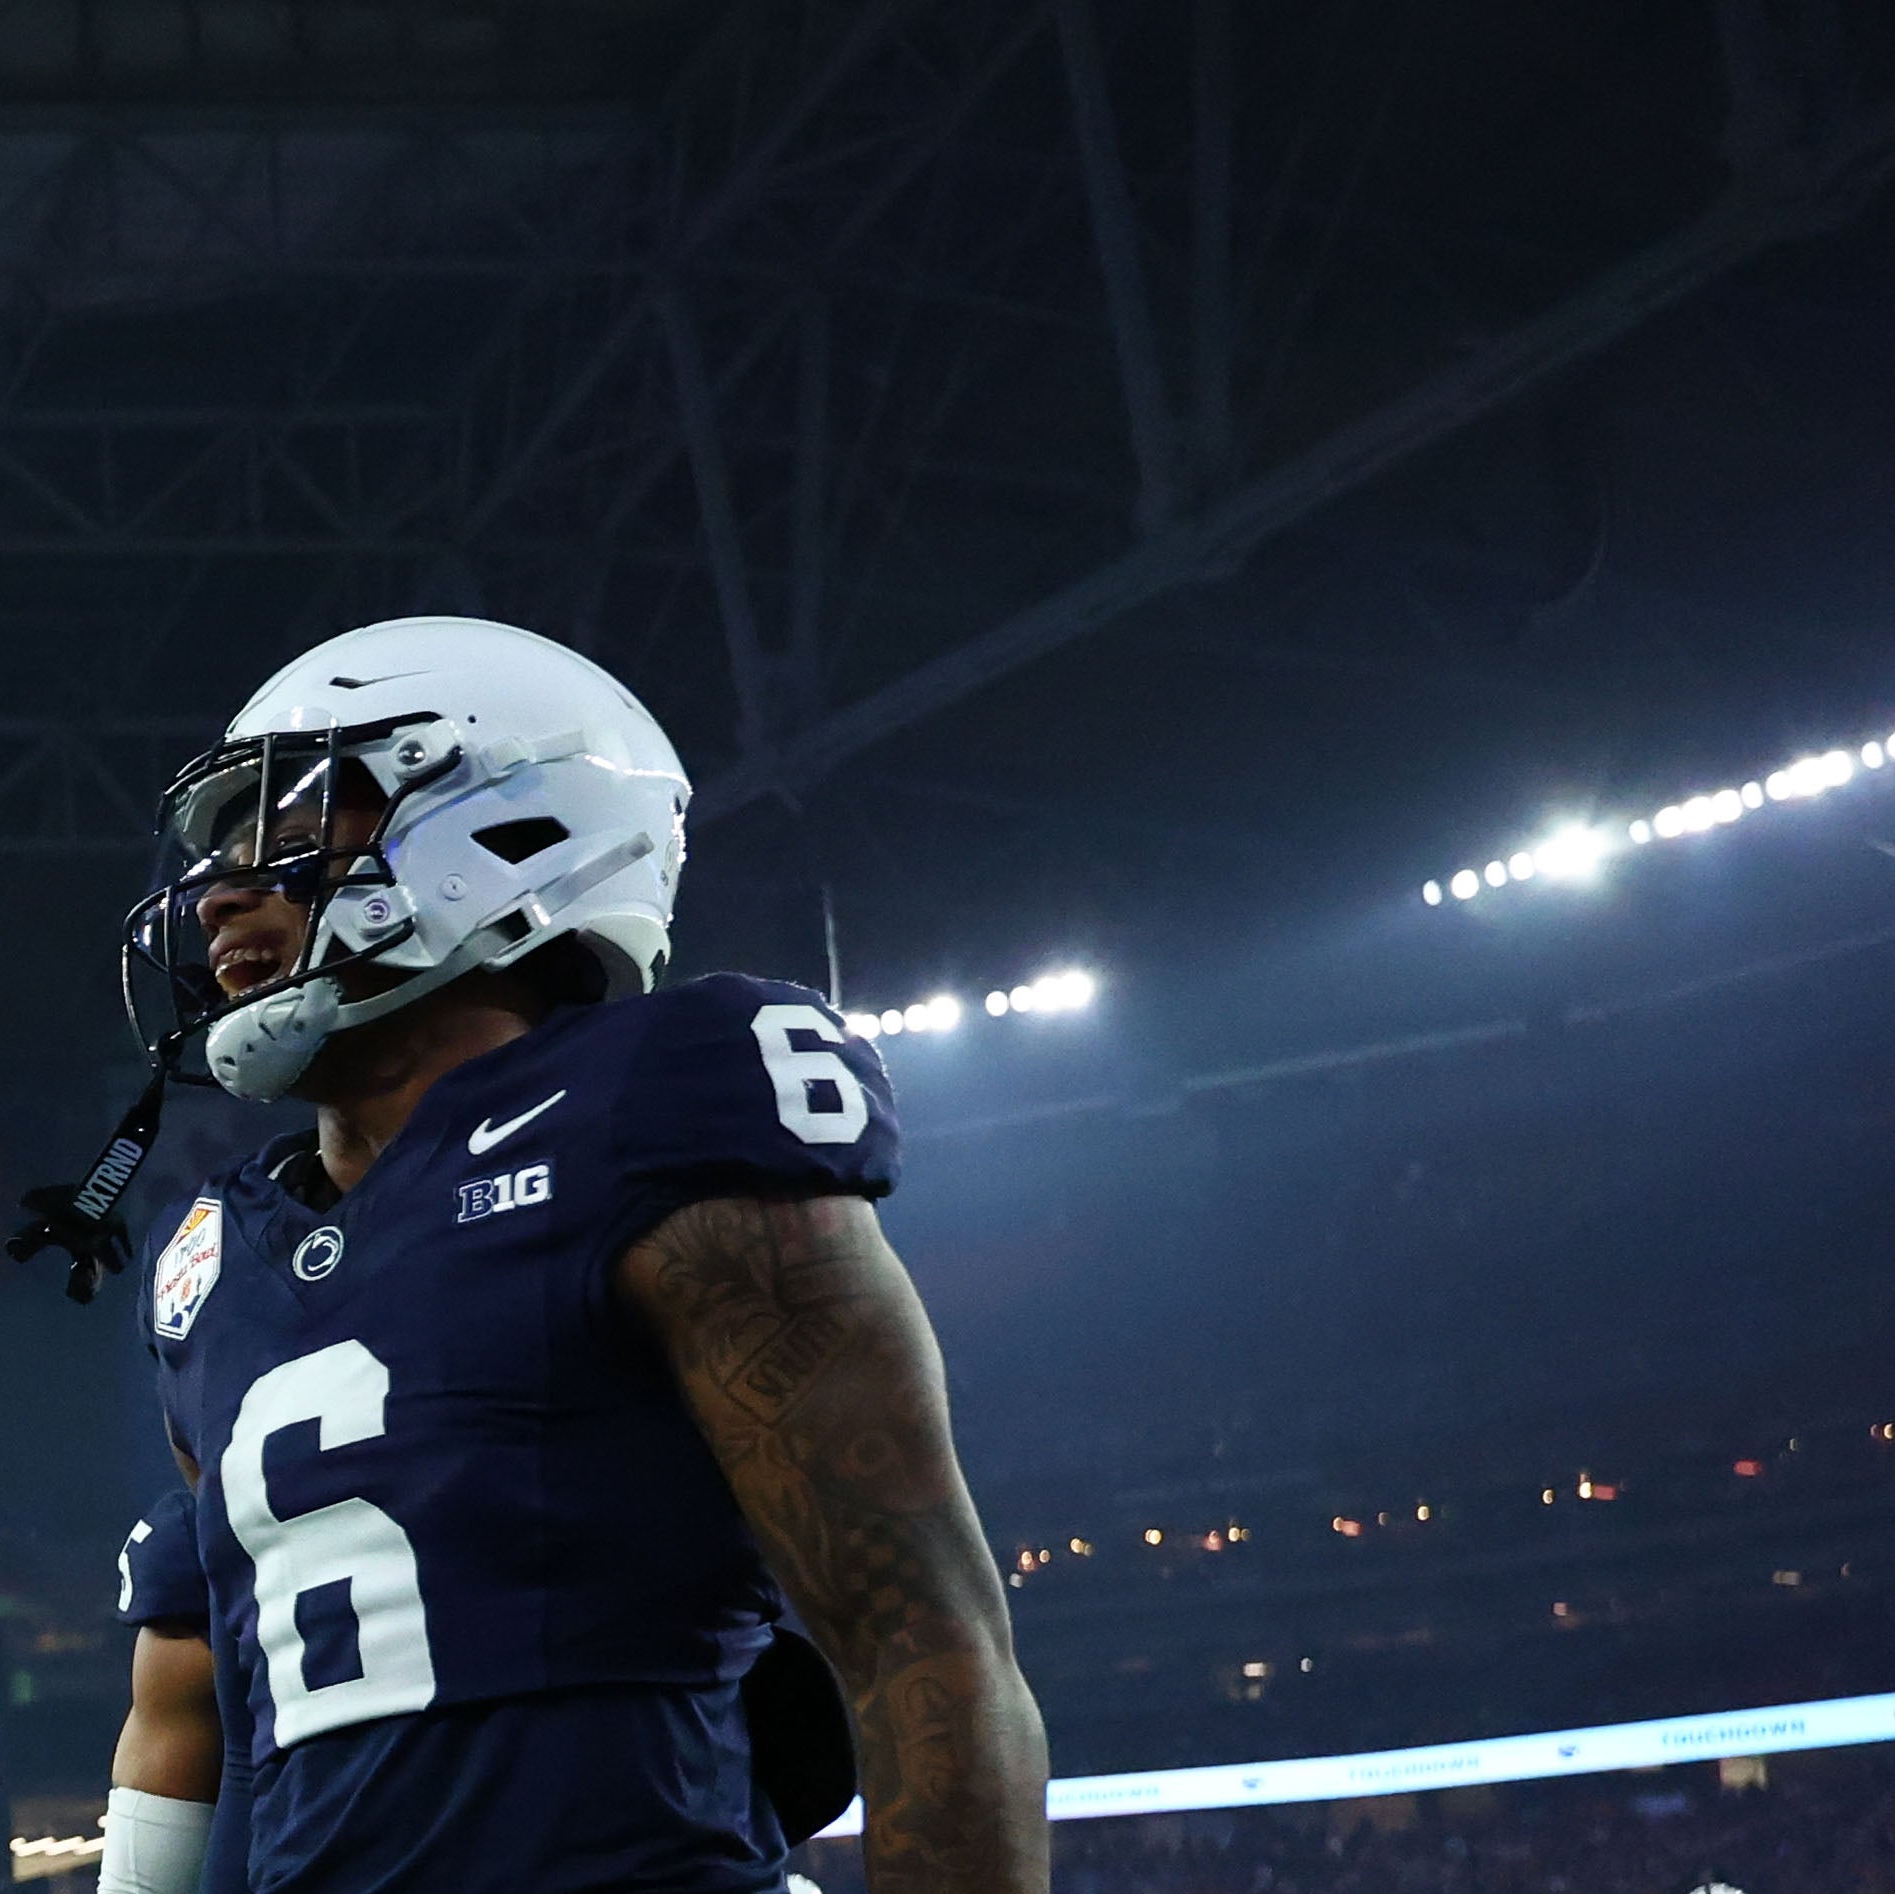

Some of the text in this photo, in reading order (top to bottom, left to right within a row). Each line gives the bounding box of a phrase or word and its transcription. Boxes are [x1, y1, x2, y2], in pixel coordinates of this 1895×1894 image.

[751, 1005, 869, 1145] 6
[73, 1138, 143, 1220] NXTRND
[221, 1340, 437, 1750] 6
